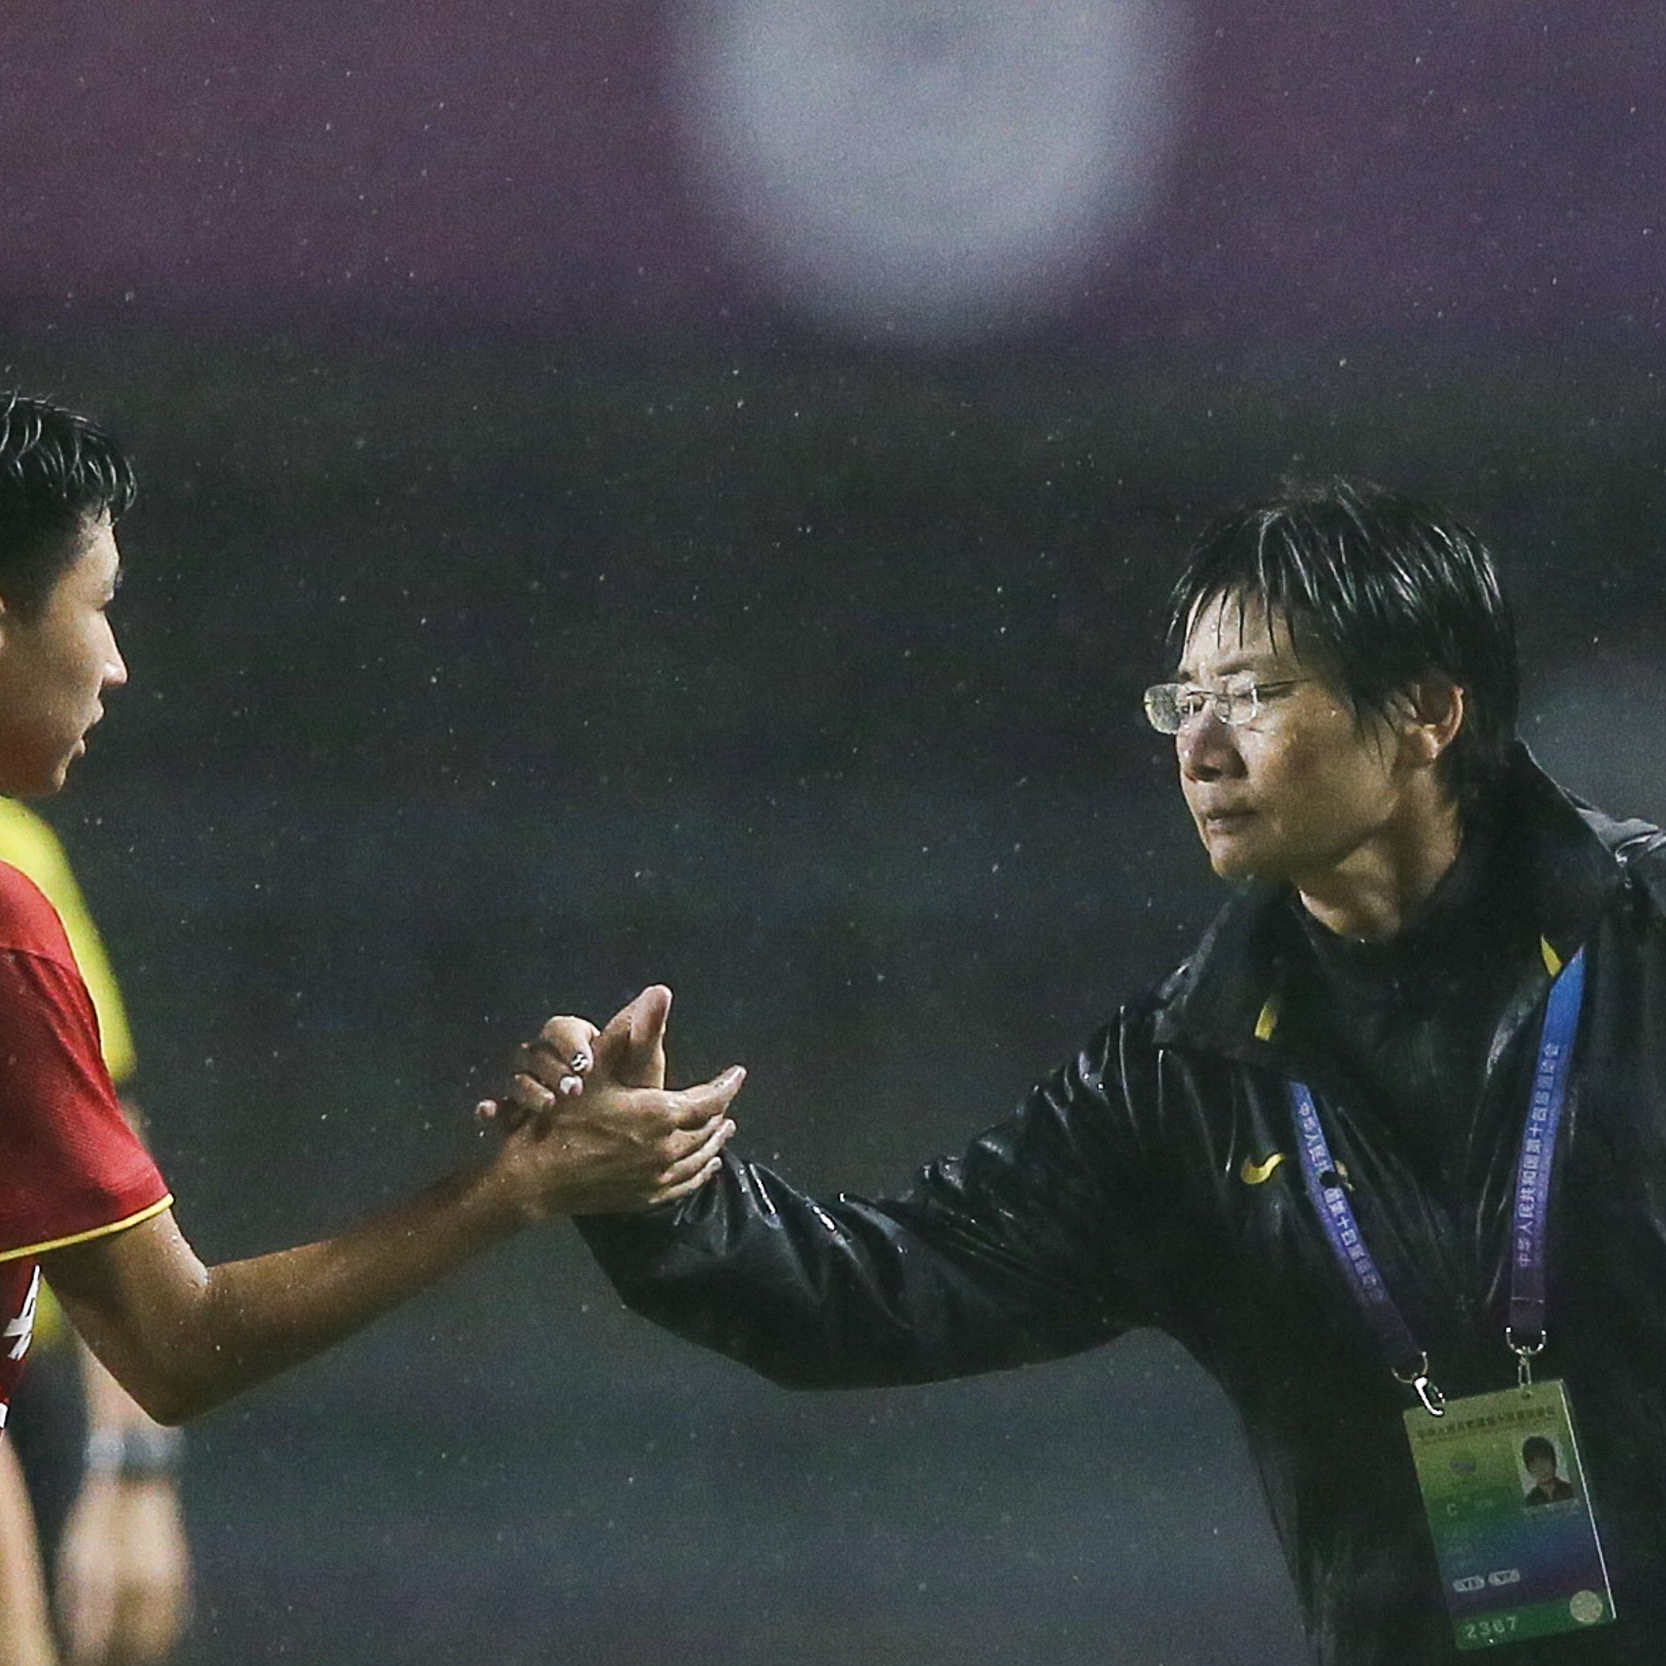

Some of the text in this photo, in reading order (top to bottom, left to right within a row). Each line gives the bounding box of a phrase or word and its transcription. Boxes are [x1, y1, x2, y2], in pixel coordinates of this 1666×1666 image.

[1297, 1101, 1384, 1302] 中华人民共国第十四届运动会
